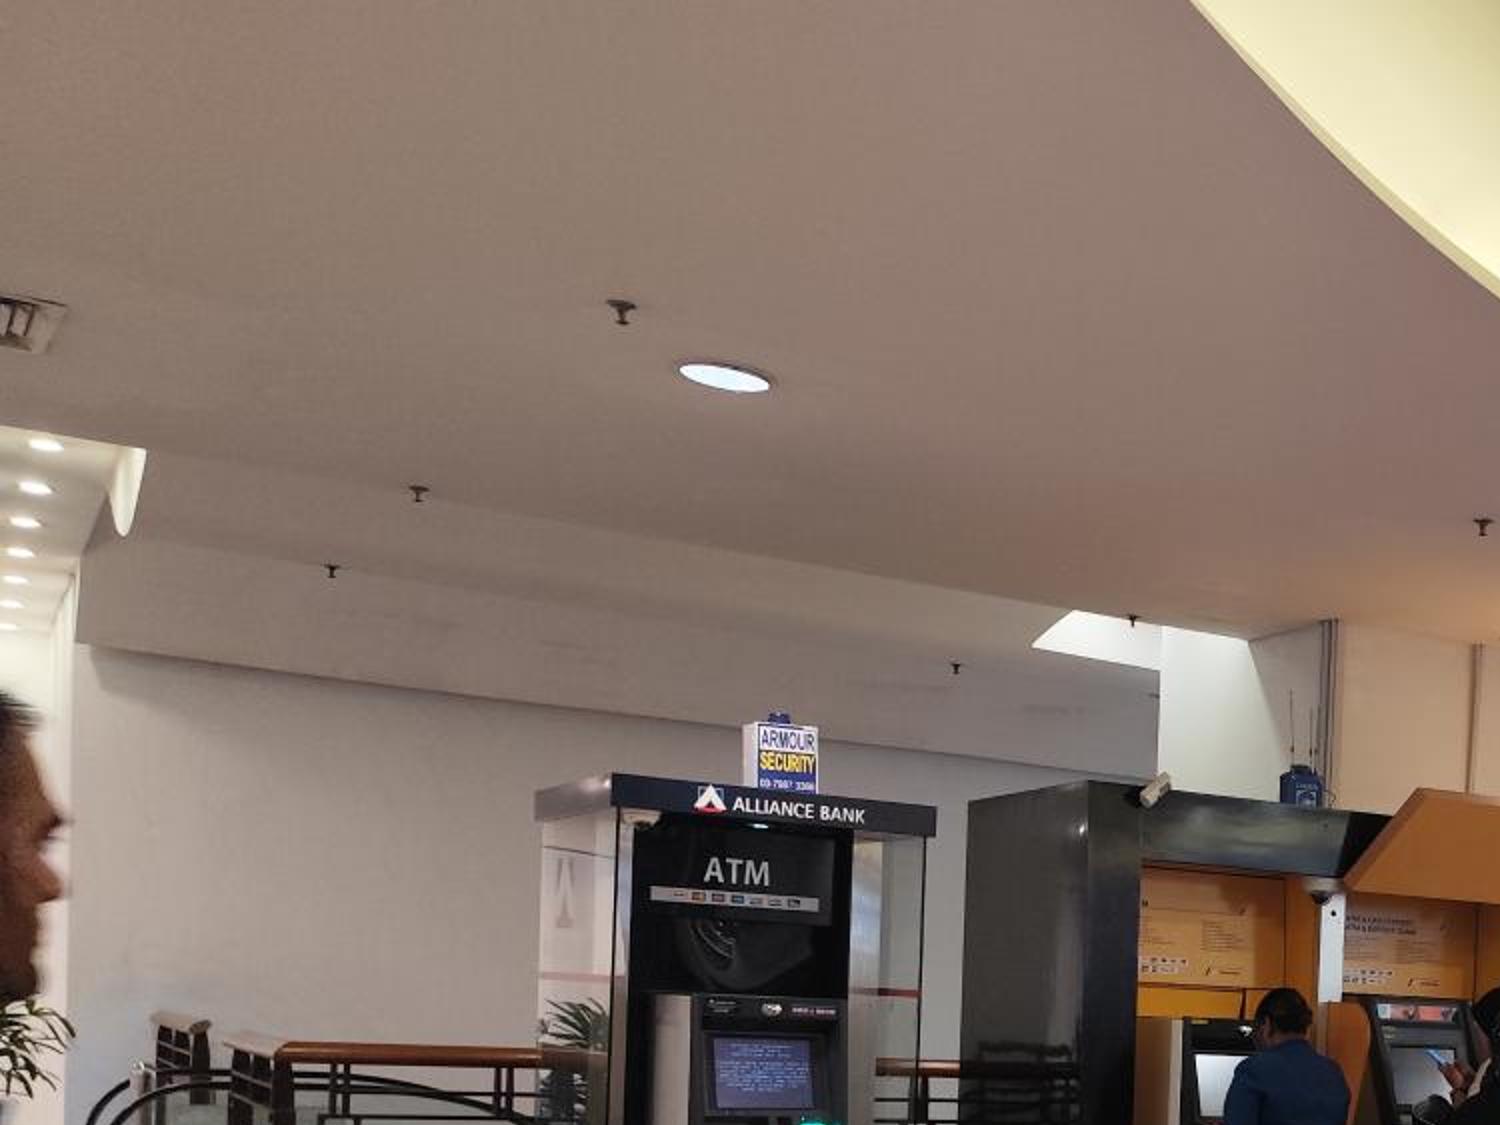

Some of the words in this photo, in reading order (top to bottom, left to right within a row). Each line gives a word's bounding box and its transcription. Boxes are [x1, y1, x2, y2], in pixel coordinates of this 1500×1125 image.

[761, 728, 815, 751] ARMOUR
[760, 751, 815, 774] SECURITY
[733, 797, 814, 819] ALLIANCE
[820, 805, 865, 824] BANK
[703, 856, 769, 887] ATM
